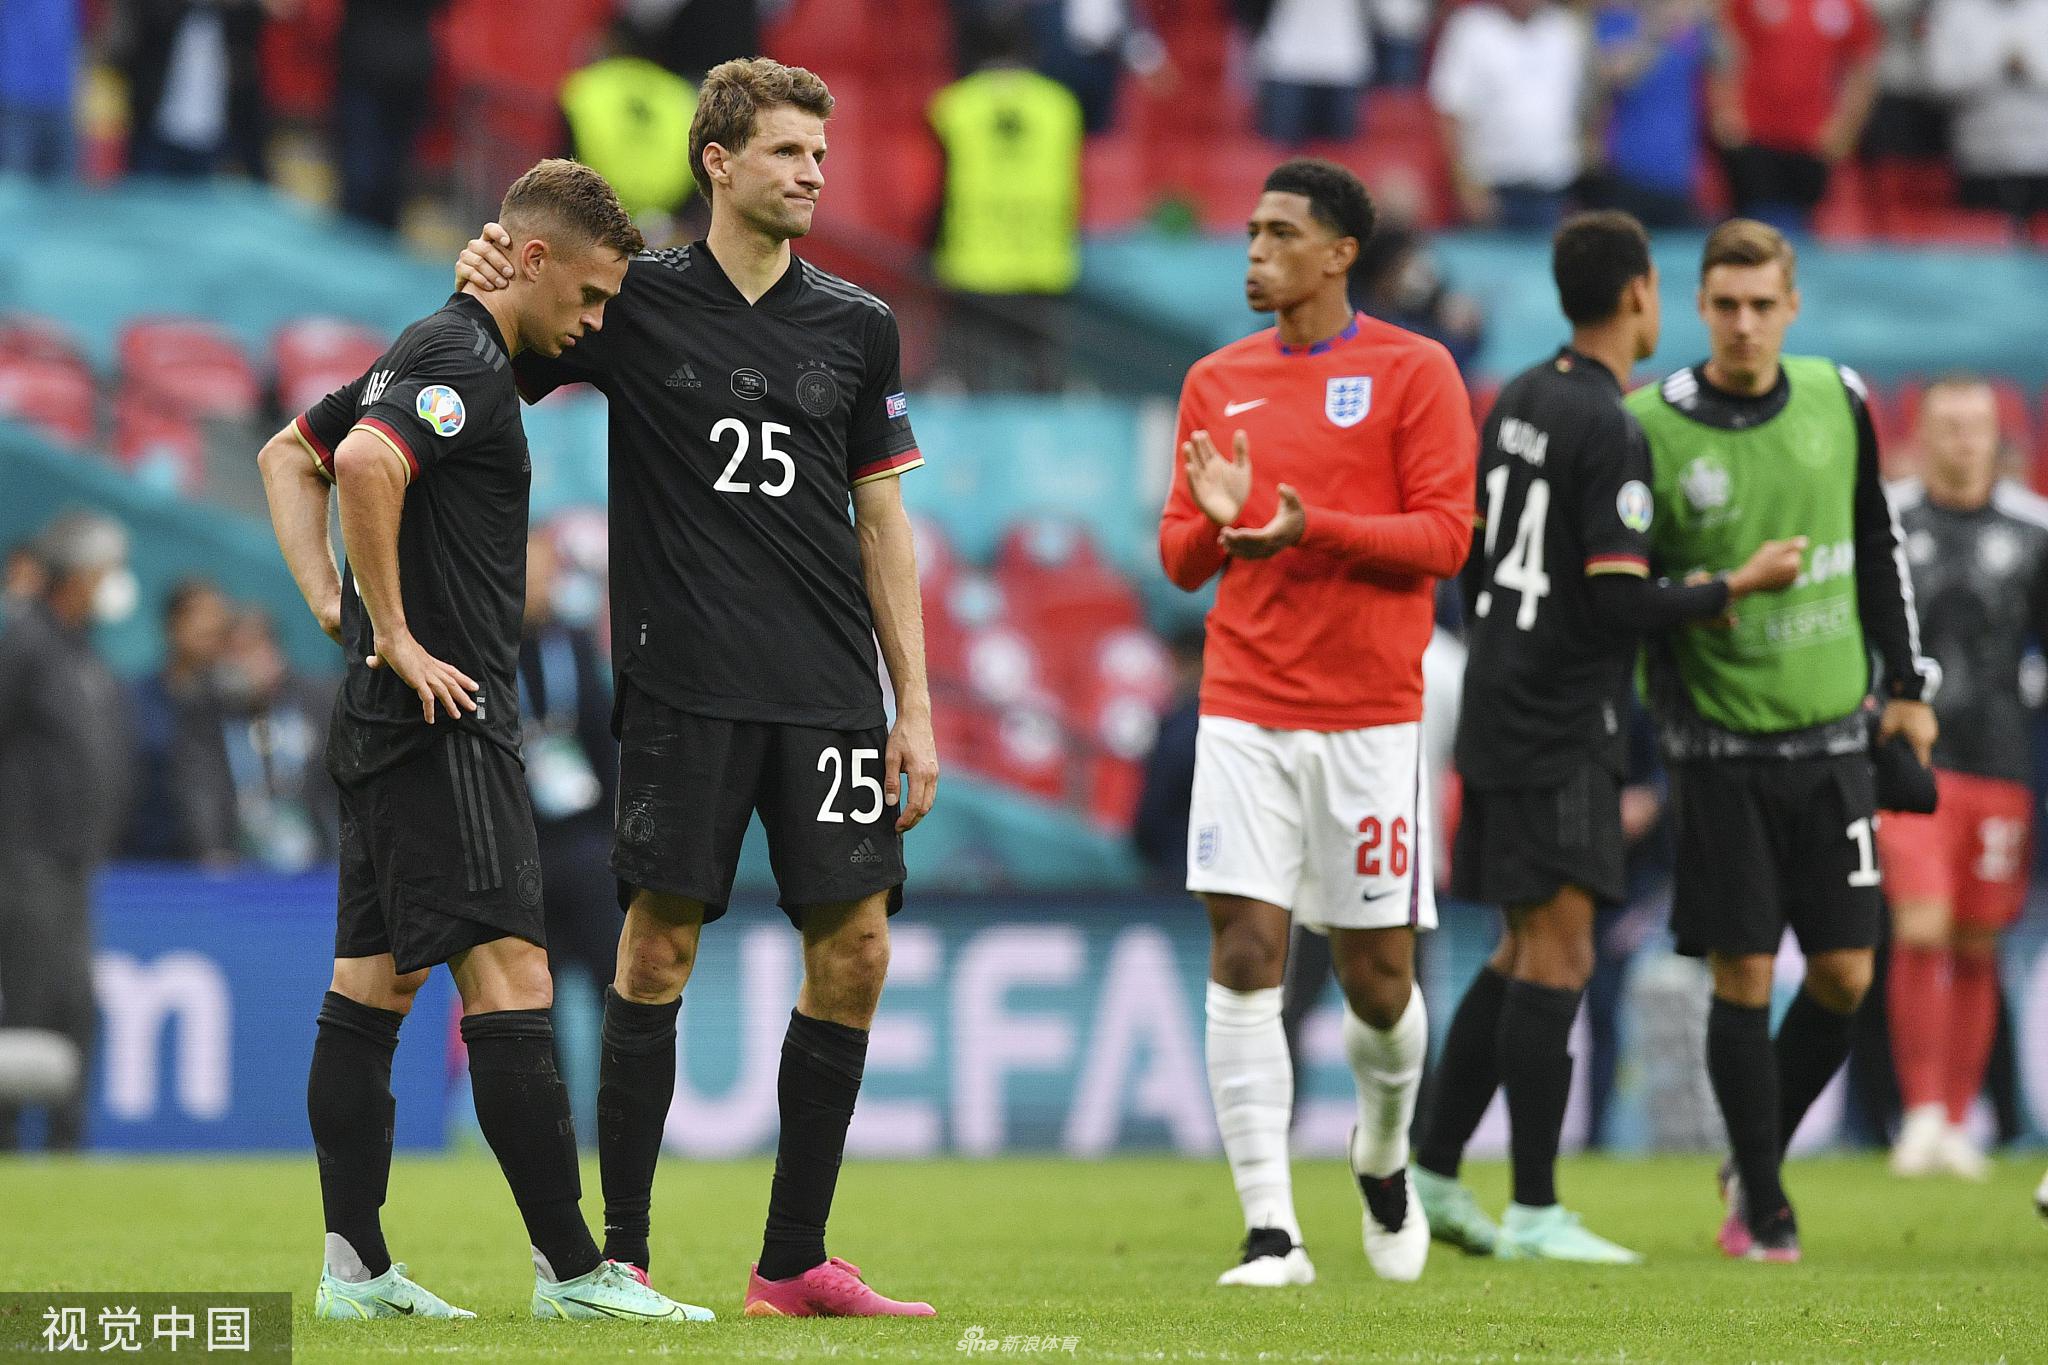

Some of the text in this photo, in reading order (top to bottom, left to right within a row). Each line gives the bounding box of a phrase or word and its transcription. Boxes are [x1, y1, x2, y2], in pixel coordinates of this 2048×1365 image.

[665, 377, 702, 388] adidas
[709, 417, 796, 497] 25
[1475, 464, 1550, 632] 14
[816, 746, 884, 824] 25
[1356, 815, 1409, 877] 26
[1846, 816, 1882, 888] 1
[668, 924, 1214, 1160] UEFA
